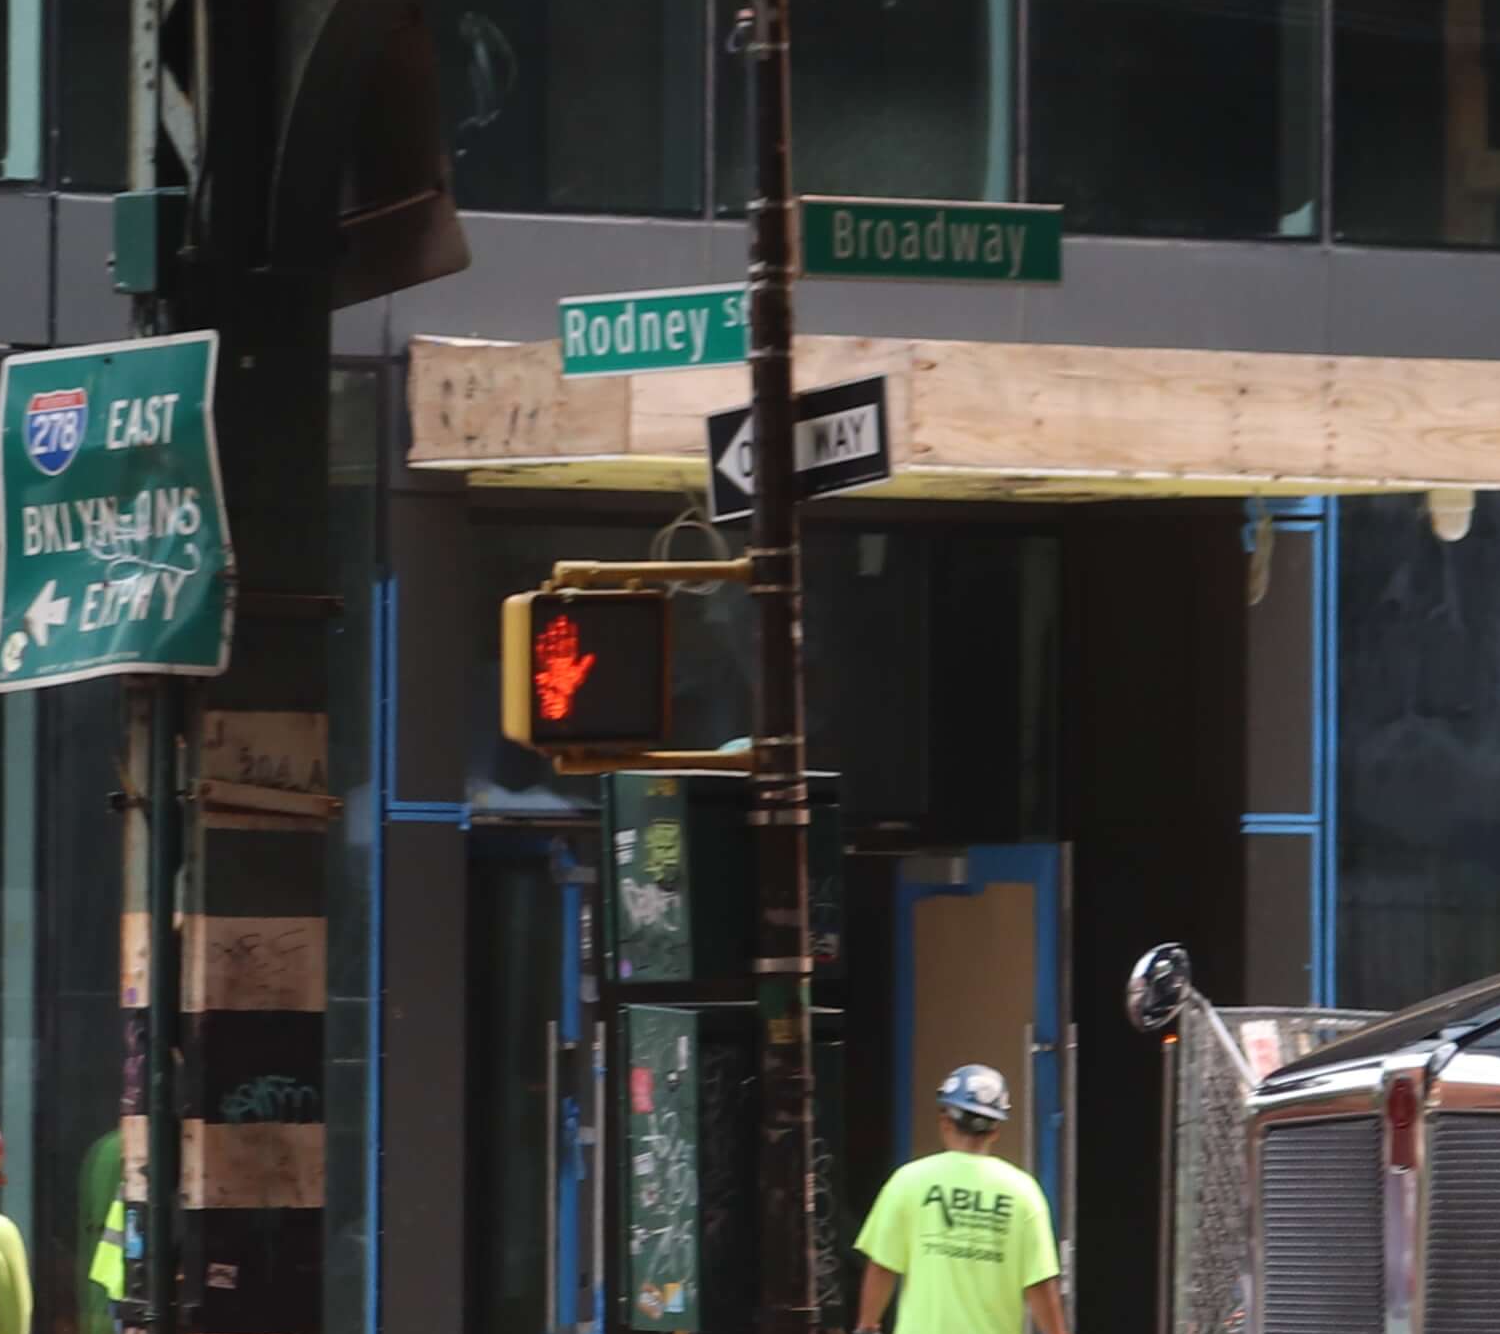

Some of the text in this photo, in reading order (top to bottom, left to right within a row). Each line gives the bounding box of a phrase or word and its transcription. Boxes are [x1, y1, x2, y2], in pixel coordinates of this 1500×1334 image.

[832, 210, 1028, 276] Broadway
[565, 302, 709, 363] Rodney
[31, 411, 78, 455] 278
[107, 393, 180, 450] EAST
[813, 413, 866, 460] WAY
[922, 1184, 1014, 1228] ABLE
